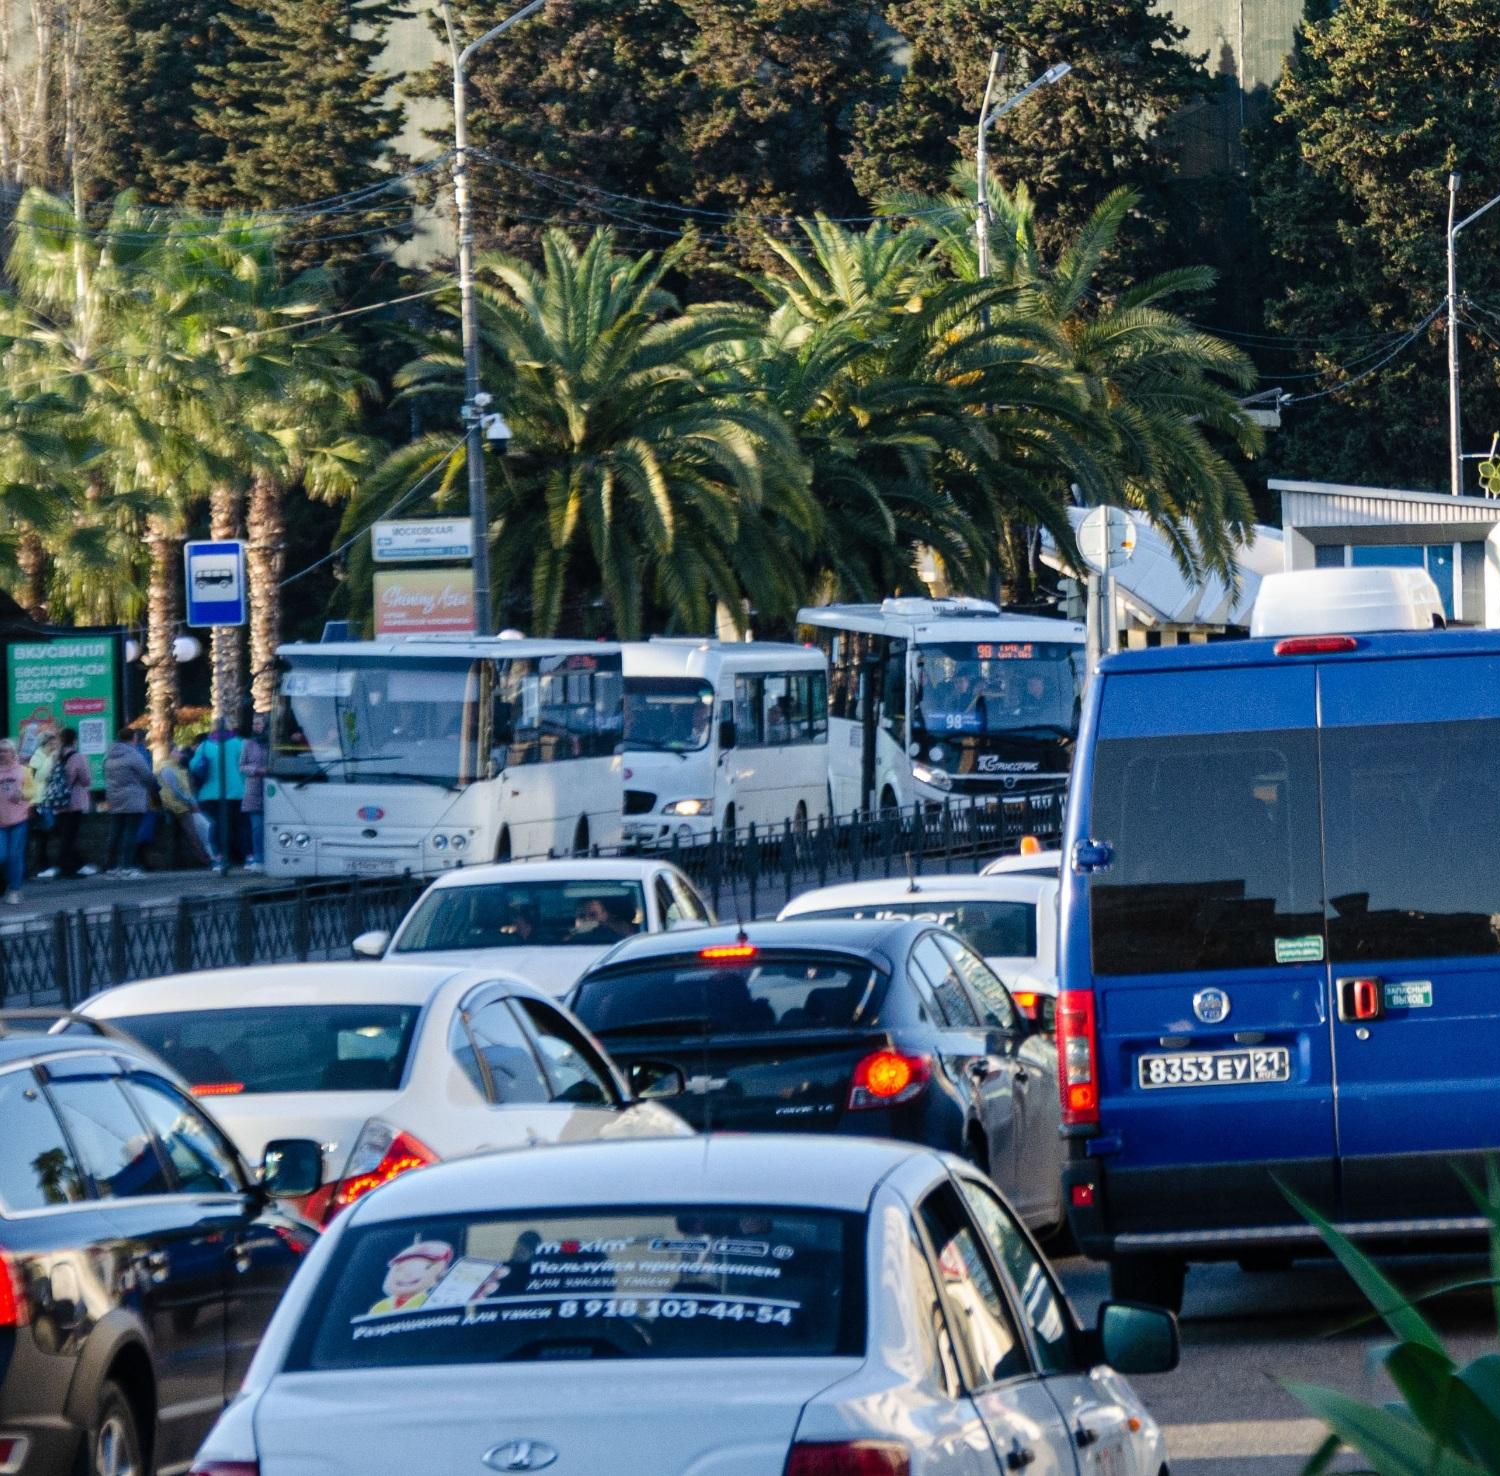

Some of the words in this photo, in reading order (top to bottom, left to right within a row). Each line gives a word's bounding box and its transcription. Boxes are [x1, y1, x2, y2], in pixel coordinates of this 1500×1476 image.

[391, 526, 453, 537] МОСКОВСКАЯ
[14, 644, 105, 660] ВКУСВИЛЛ
[14, 664, 106, 678] БЕСПЛАТНАЯ
[946, 714, 962, 729] 98
[1393, 993, 1424, 1005] ВЫХОД
[1254, 1052, 1280, 1072] 21
[534, 1238, 629, 1255] maxim
[530, 1261, 636, 1275] Пользуйся
[638, 1262, 782, 1279] приложением
[526, 1277, 561, 1290] для
[352, 1315, 460, 1341] Разрешение
[461, 1311, 498, 1326] для
[501, 1307, 552, 1321] такси
[558, 1301, 578, 1319] 8
[584, 1300, 638, 1319] 918
[645, 1300, 792, 1327] 103-44-54
